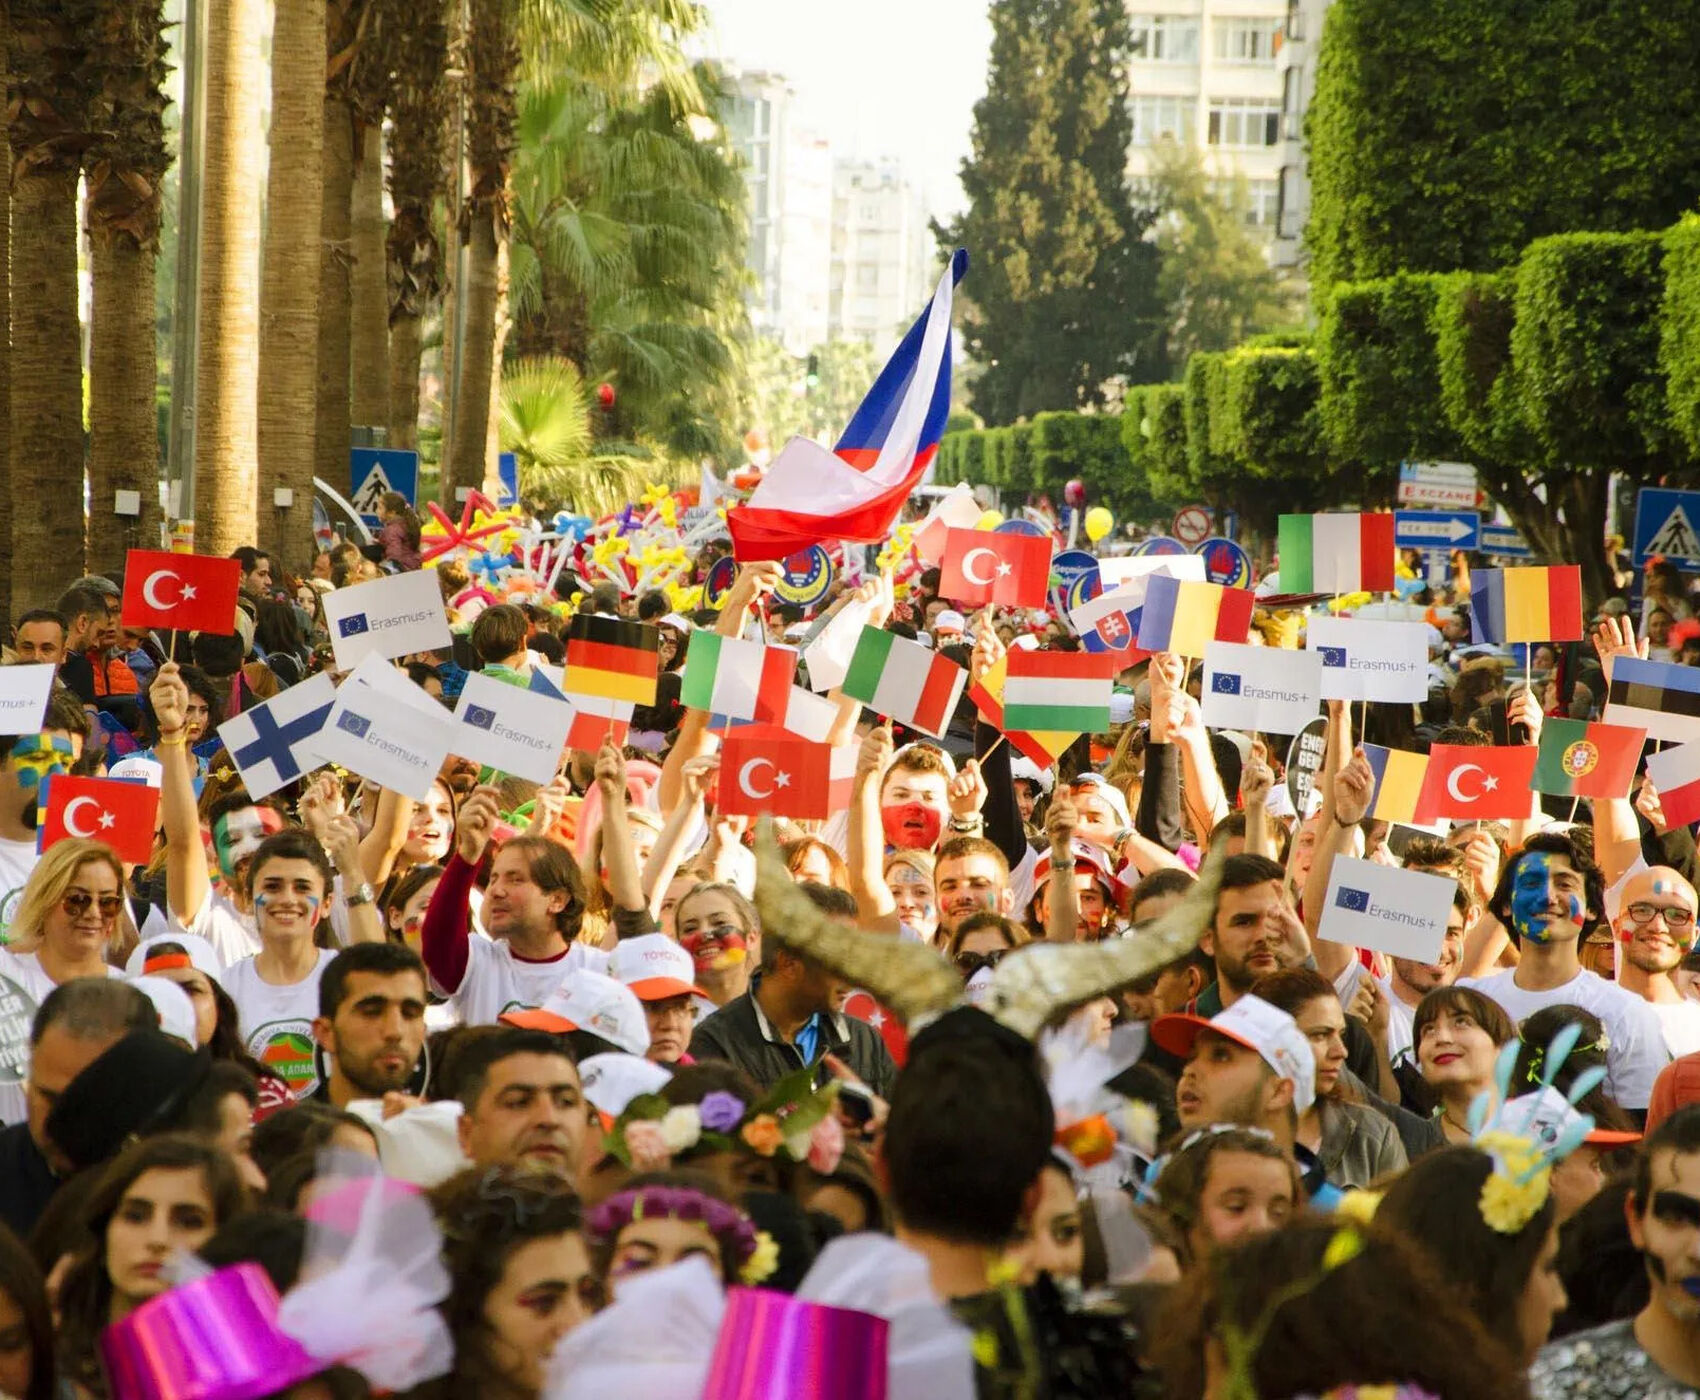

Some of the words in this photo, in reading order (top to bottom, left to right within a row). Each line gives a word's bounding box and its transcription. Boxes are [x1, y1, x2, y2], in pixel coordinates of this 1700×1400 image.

[371, 609, 435, 631] Erasmus+
[1350, 658, 1416, 672] Erasmus+
[1243, 685, 1309, 702] Erasmus+
[493, 723, 552, 751] Erasmus+
[367, 732, 429, 768] Erasmus+
[1369, 904, 1436, 929] Erasmus+
[641, 951, 681, 961] TOYOTA
